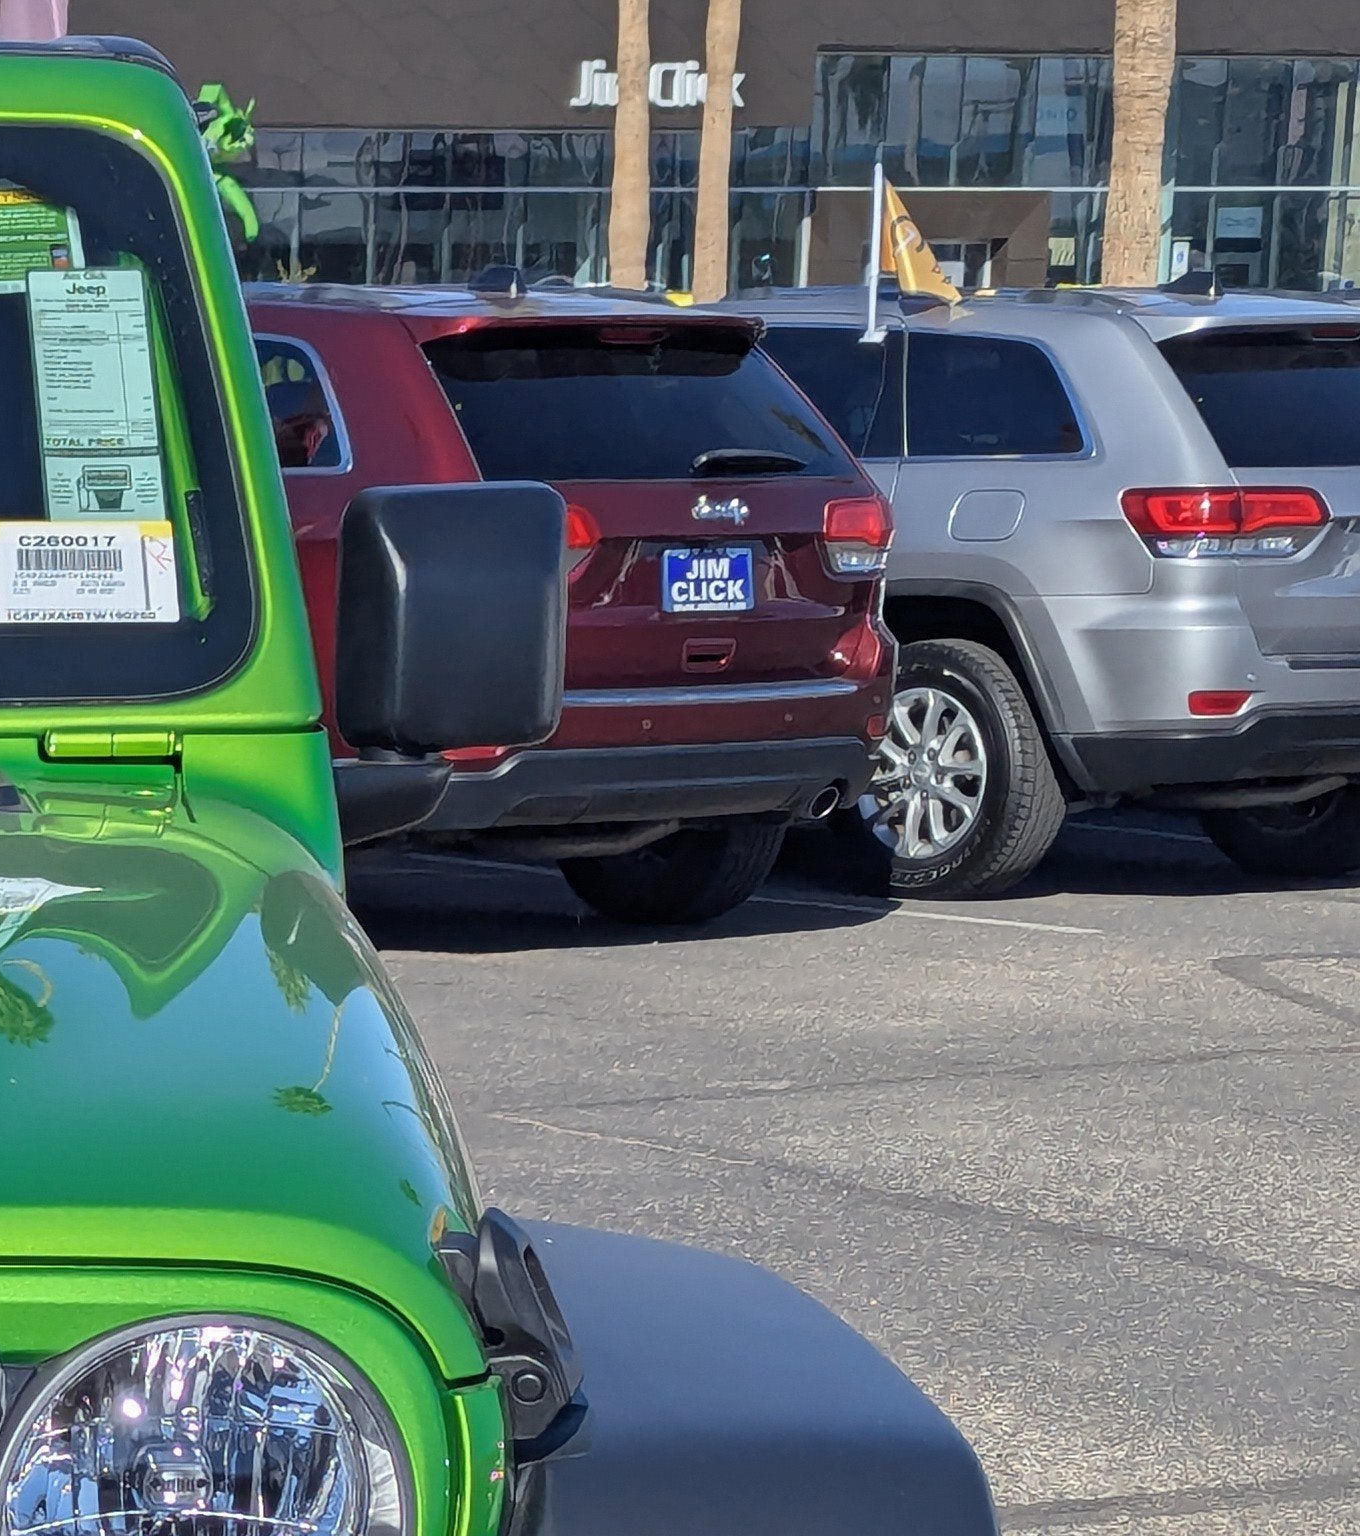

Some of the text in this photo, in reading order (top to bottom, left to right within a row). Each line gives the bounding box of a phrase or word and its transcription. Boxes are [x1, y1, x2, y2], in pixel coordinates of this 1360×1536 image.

[65, 283, 107, 297] Jeep
[45, 438, 84, 447] TOTAL
[18, 535, 117, 547] C260017
[686, 557, 731, 580] JIM
[671, 579, 746, 603] CLICK
